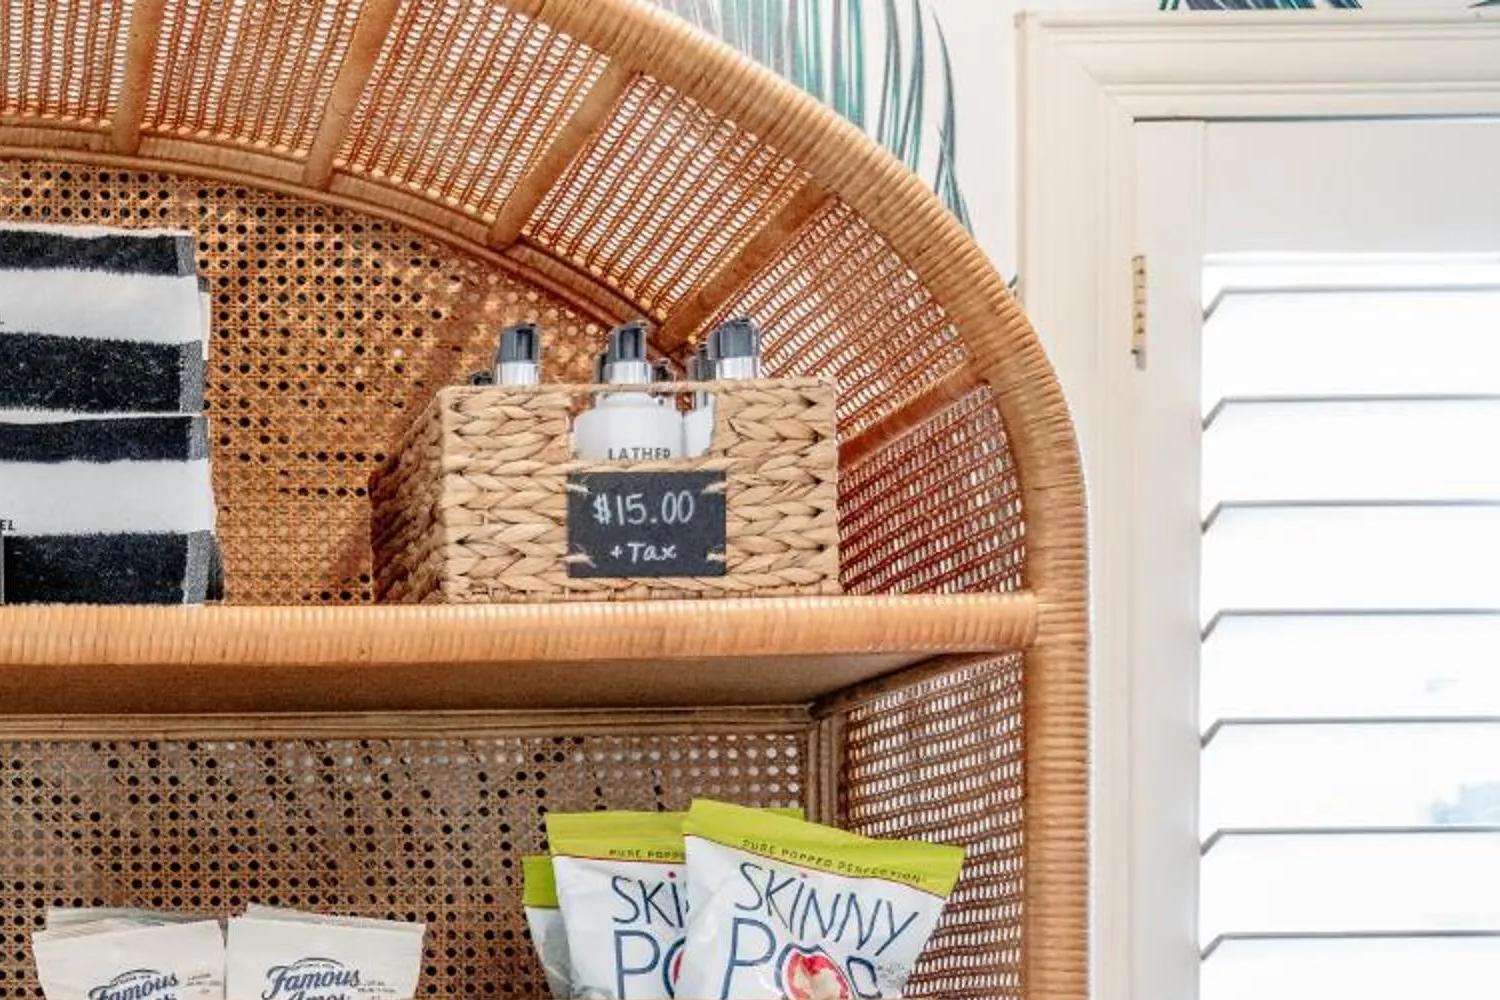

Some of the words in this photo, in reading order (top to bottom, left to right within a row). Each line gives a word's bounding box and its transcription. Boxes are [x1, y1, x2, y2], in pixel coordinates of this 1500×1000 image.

[608, 447, 671, 460] LATHER
[593, 490, 695, 525] $15.00
[742, 839, 774, 855] PURE
[781, 849, 832, 867] POPPED
[262, 965, 360, 1000] Famous
